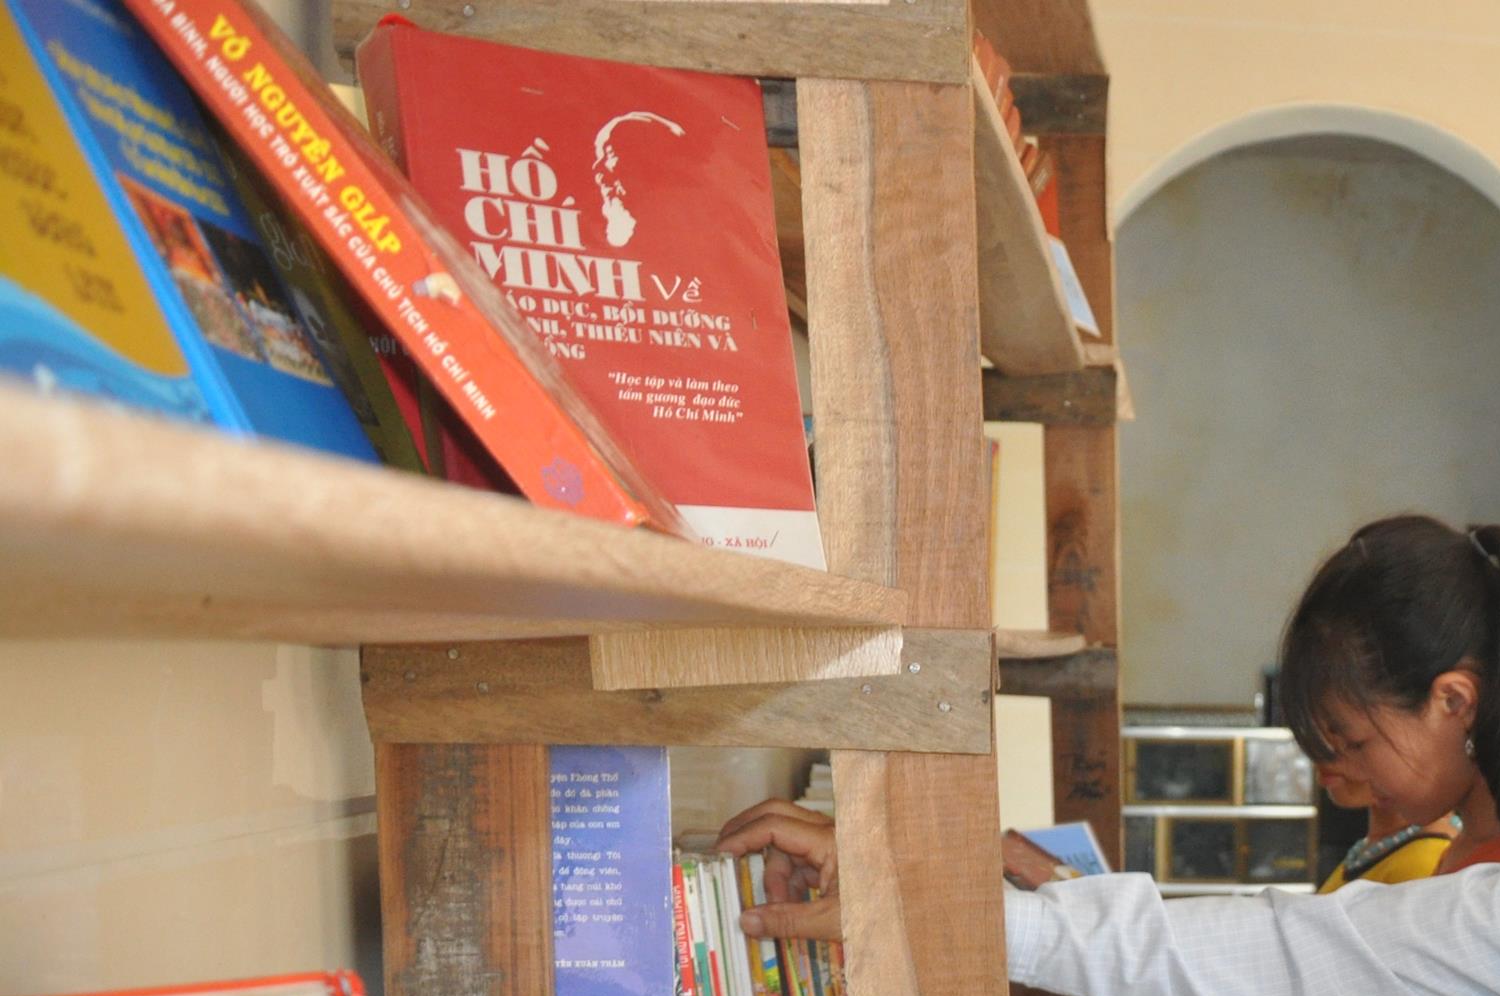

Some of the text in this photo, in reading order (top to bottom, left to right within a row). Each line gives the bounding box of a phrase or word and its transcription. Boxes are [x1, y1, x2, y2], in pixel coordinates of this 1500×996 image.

[455, 137, 558, 201] HỒ
[339, 186, 401, 254] GIÁP
[464, 196, 586, 250] CHÍ
[242, 102, 275, 139] HỌC
[269, 135, 298, 168] TRÒ
[292, 165, 331, 208] XUẤT
[323, 205, 354, 238] SẮC
[349, 235, 377, 270] CỦA
[372, 267, 404, 300] CHỦ
[398, 297, 430, 334] TỊCH
[424, 331, 449, 356] HỒ
[441, 354, 470, 385] CHÍ
[462, 382, 497, 421] MINH
[470, 241, 646, 302] MINH
[542, 296, 598, 322] DỤC,
[603, 300, 647, 326] BỒI
[652, 307, 731, 332] DƯỠNG
[571, 321, 642, 344] THIẾU
[648, 327, 702, 349] NIÊN
[707, 331, 739, 352] VÀ
[618, 387, 741, 409] tấm gương đạo đức
[644, 375, 666, 391] tập
[668, 376, 684, 389] và
[685, 376, 710, 391] làm
[712, 379, 740, 393] theo
[675, 406, 699, 421] Chí
